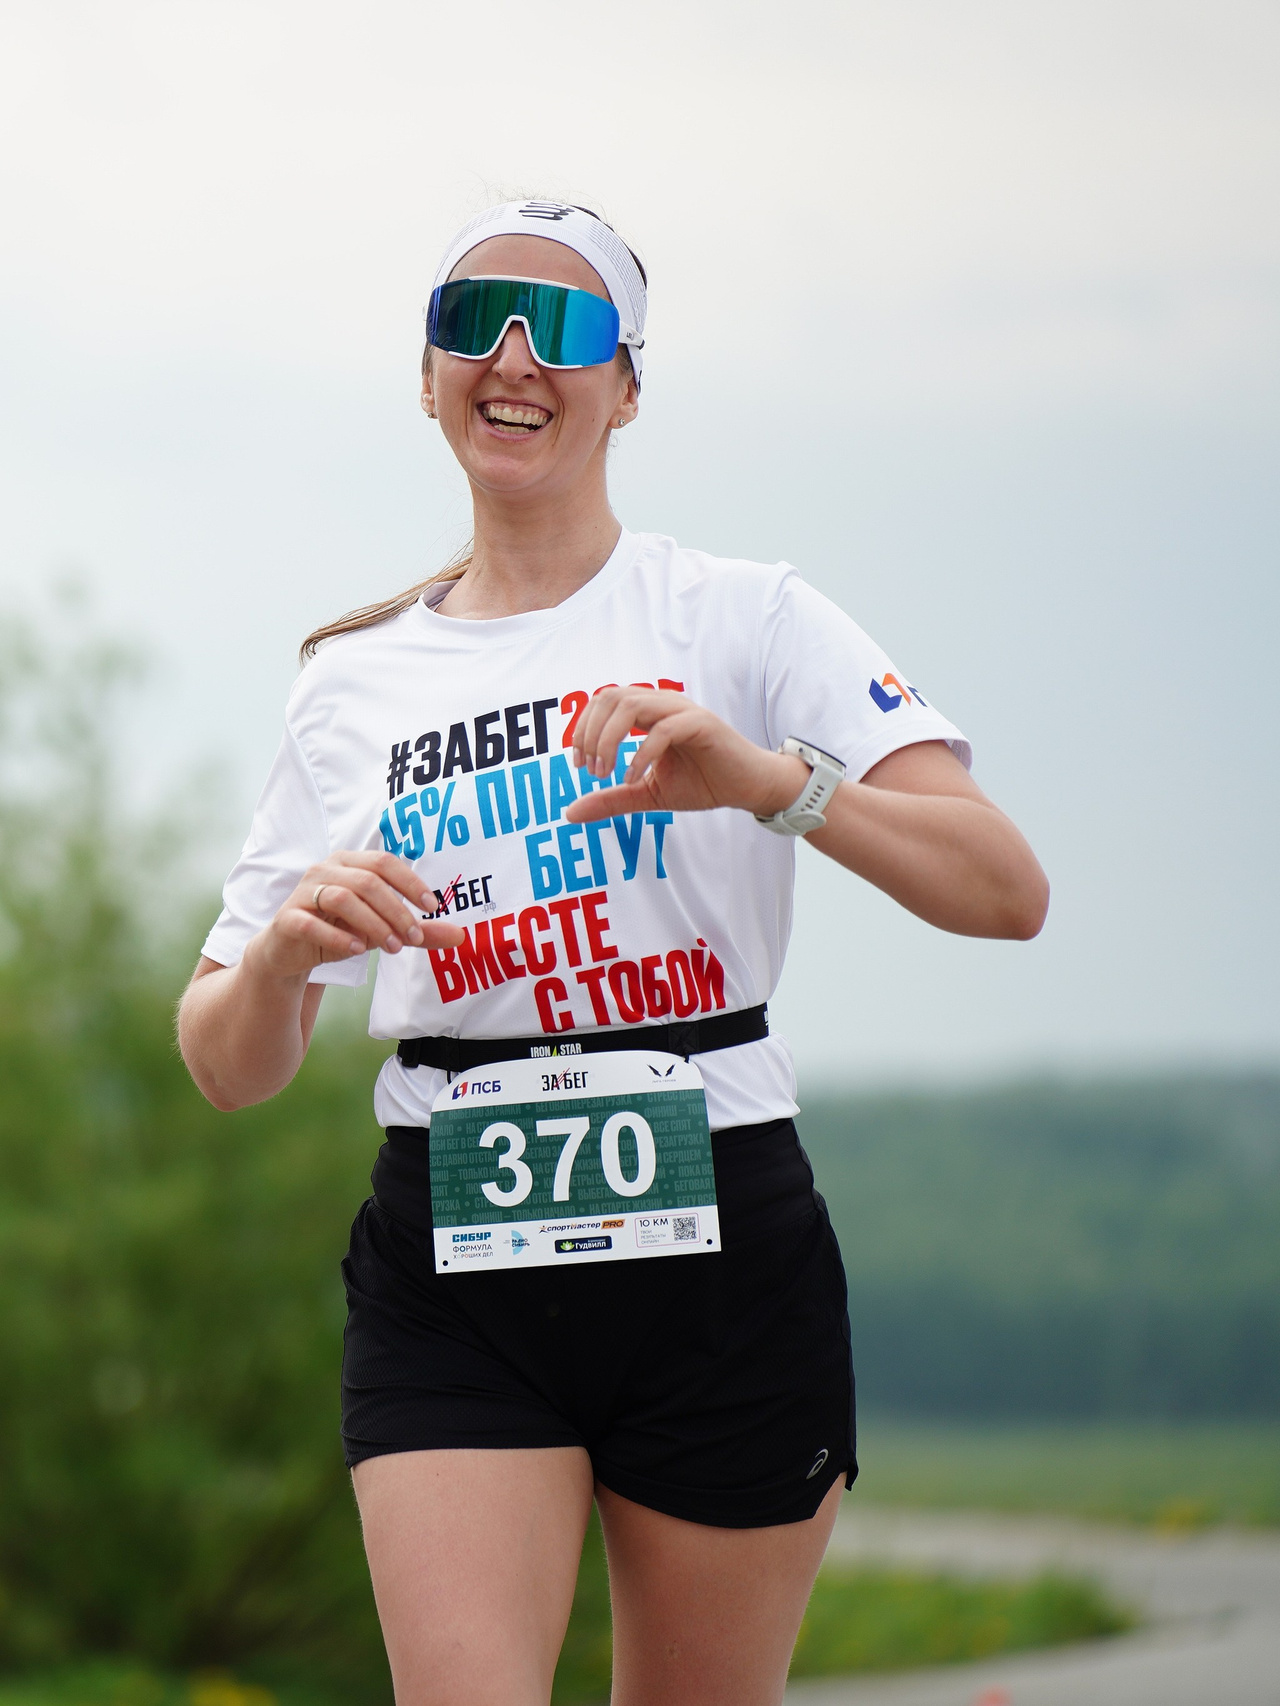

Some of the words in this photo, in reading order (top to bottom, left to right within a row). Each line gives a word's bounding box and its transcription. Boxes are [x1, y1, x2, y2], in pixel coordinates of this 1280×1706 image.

[387, 678, 685, 800] #ЗАБЕГ2
[524, 812, 673, 901] БЕГУТ
[428, 891, 619, 1004] ВМЕСТЕ
[534, 977, 575, 1034] С
[576, 938, 726, 1026] ТОБОЙ
[531, 1045, 551, 1058] IRON
[560, 1043, 582, 1056] STAR
[471, 1080, 501, 1094] ПСБ
[542, 1071, 588, 1091] ЗАБЕГ
[479, 1111, 657, 1208] 370
[575, 1158, 601, 1171] ЖИЗН
[602, 1221, 624, 1229] PRO
[639, 1219, 650, 1228] 10
[452, 1231, 492, 1243] СИБУР
[452, 1244, 493, 1253] ФОРМУЛА
